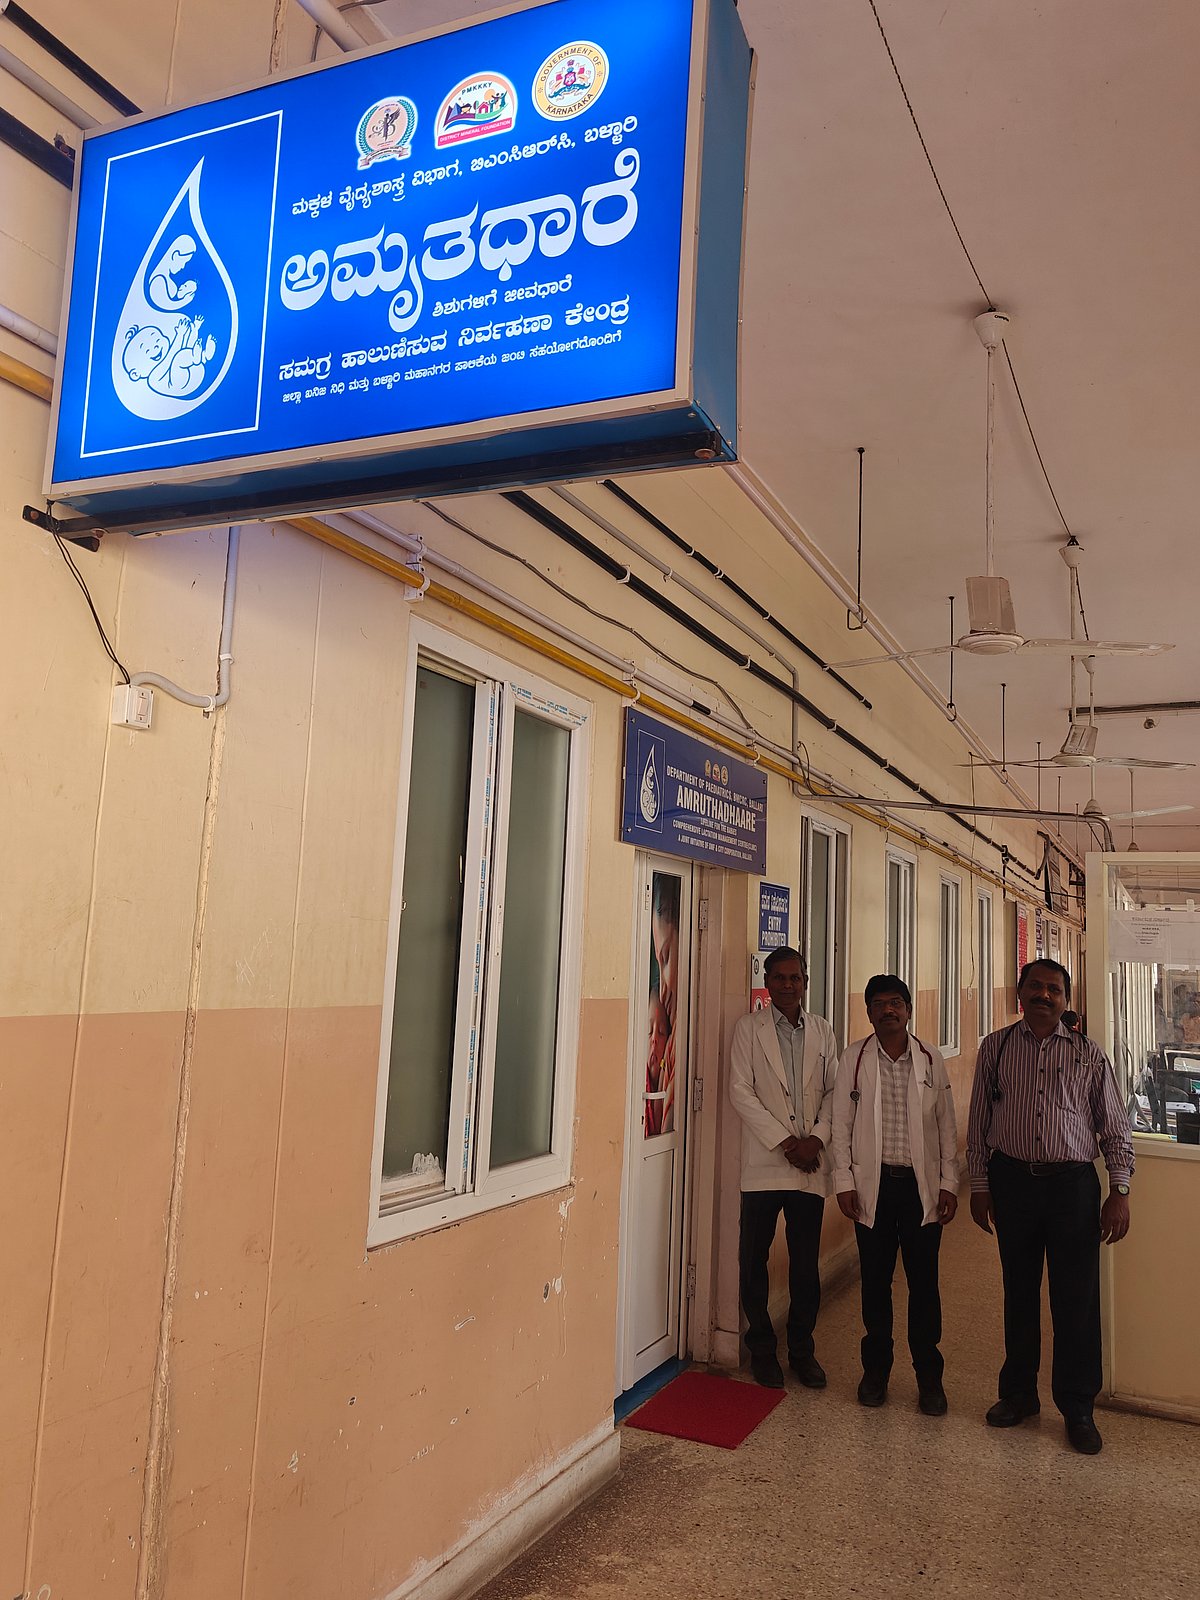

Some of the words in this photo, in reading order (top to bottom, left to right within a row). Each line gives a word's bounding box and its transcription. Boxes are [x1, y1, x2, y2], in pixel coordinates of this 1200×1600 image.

[541, 46, 593, 82] GOVERNMENT
[592, 55, 602, 67] OF
[461, 81, 493, 96] PMKKKY
[546, 92, 594, 115] KARNATAKA
[439, 132, 460, 143] DISTRICT
[460, 127, 481, 138] MINERAL
[480, 119, 511, 132] FOUNDATION
[291, 190, 333, 219] ಮಕ್ಕಳ
[338, 172, 406, 211] ವೈದ್ಯಶಾಸ್ತ್ರ
[411, 158, 463, 187] ವಿಭಾಗ,
[584, 115, 638, 145] ಬಳ್ಳಾರಿ
[280, 147, 641, 333] ಅಮೃತಧಾರೆ
[431, 288, 498, 317] ಶಿಶುಗಳಿಗೆ
[503, 273, 573, 303] ಜೀವಧಾರೆ
[278, 351, 332, 381] ಸಮಗ್ರ
[341, 329, 448, 369] ಹಾಲುಣಿಸುವ
[457, 314, 553, 347] ನಿರ್ವಹಣಾ
[564, 292, 631, 326] ಕೇಂದ್ರ
[282, 390, 302, 405] ಜಿಲ್ಲಾ
[304, 384, 327, 399] ಖನಿಜ
[329, 381, 346, 395] ನಿಧಿ
[348, 377, 370, 392] ಮತ್ತು
[372, 371, 401, 390] ಬಳ್ಳಾರಿ
[404, 361, 452, 381] ಮಹಾನಗರ
[454, 352, 497, 372] ಪಾಲಿಕೆಯ
[501, 350, 525, 364] ಜಂಟಿ
[529, 329, 622, 358] ಸಹಯೋಗದೊಂದಿಗೆ
[666, 765, 698, 787] DEPARTMENT
[698, 778, 705, 789] OF
[676, 784, 756, 833] AMRUTHADHAARE
[768, 915, 782, 931] ENTRY
